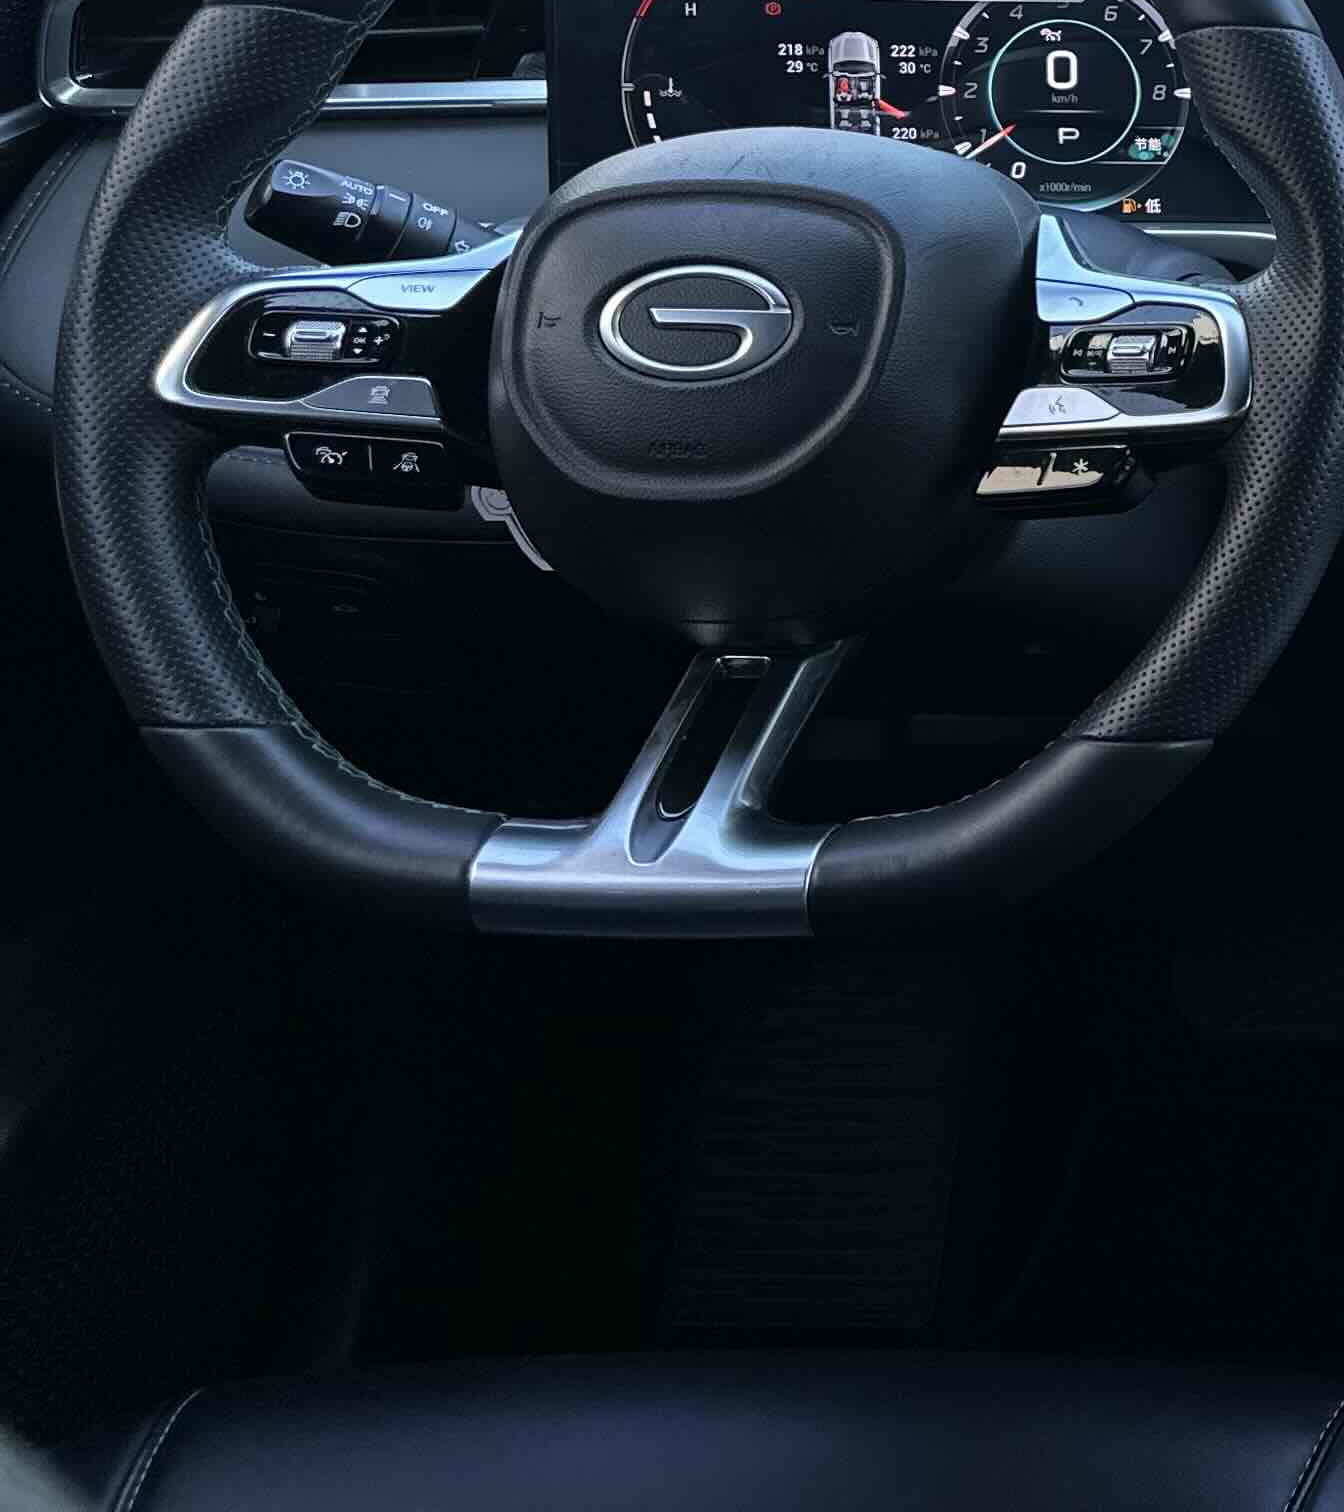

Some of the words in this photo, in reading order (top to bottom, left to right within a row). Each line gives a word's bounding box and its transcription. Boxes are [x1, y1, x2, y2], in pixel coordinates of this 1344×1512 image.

[684, 3, 697, 16] H
[1009, 5, 1023, 19] 4
[1104, 5, 1118, 20] 6
[777, 43, 803, 56] 218
[805, 44, 825, 56] kPa
[890, 45, 916, 57] 222
[918, 46, 938, 58] kPa
[974, 38, 988, 54] 3
[1139, 39, 1153, 54] 7
[786, 61, 803, 73] 29
[899, 62, 916, 74] 30
[1045, 49, 1078, 90] 0
[963, 83, 977, 99] 2
[1051, 93, 1078, 104] km/h
[1152, 85, 1166, 100] 8
[891, 128, 917, 139] 220
[920, 128, 939, 139] kPa
[1058, 127, 1080, 144] P
[1134, 136, 1161, 151] 节能
[1011, 161, 1026, 178] 0
[341, 179, 374, 196] AUTO
[423, 202, 449, 216] OFF
[1144, 198, 1162, 214] 低
[401, 283, 435, 294] VIEW
